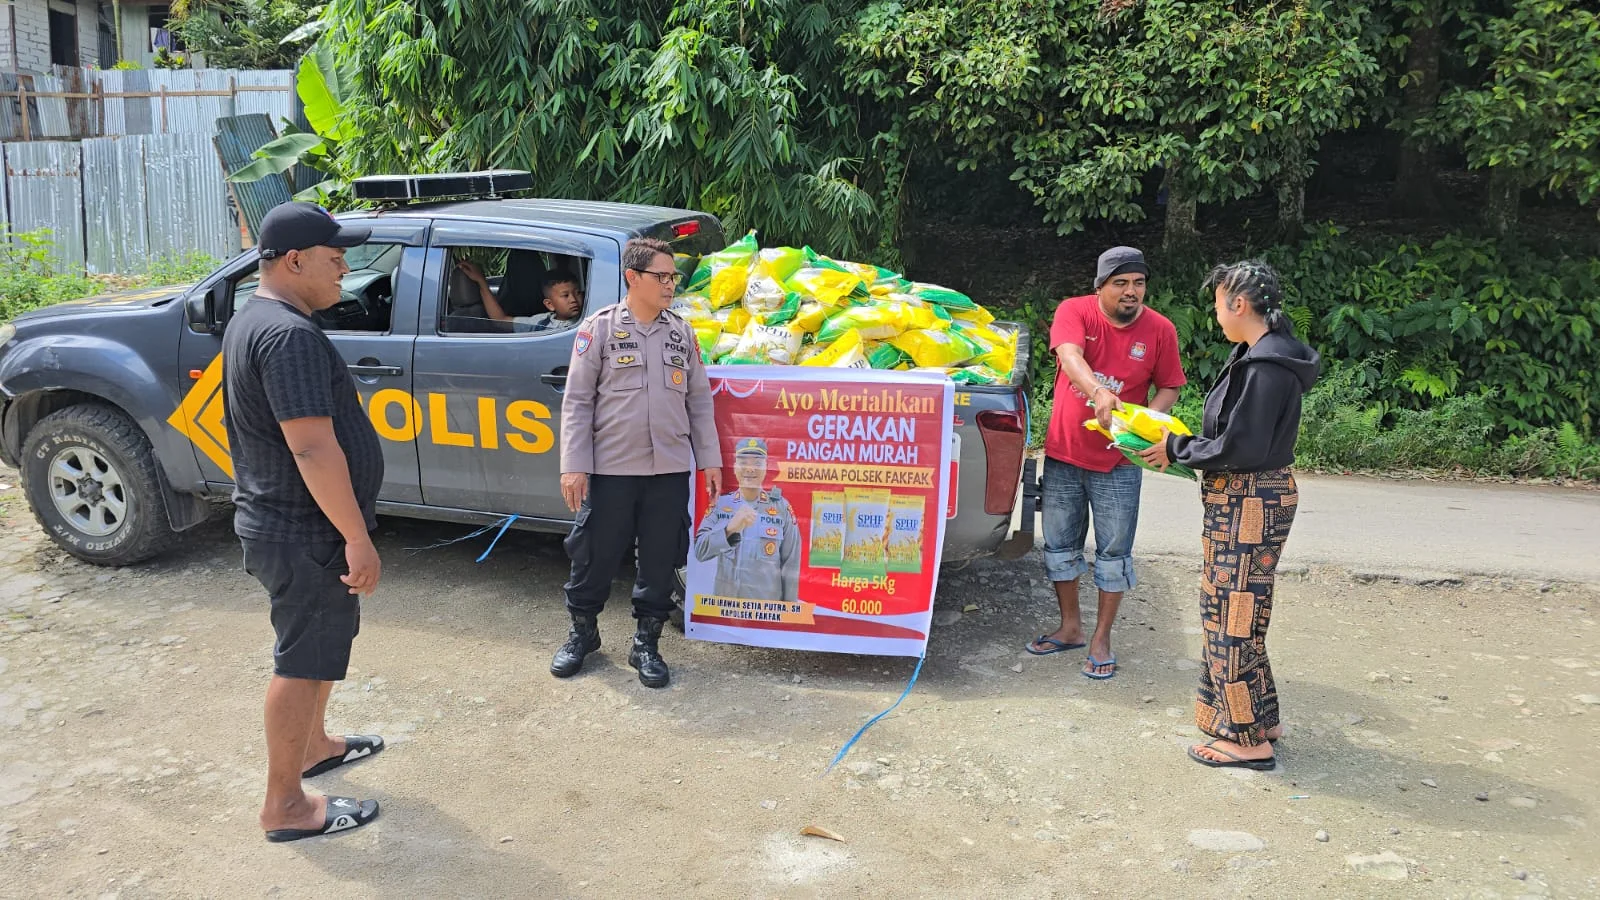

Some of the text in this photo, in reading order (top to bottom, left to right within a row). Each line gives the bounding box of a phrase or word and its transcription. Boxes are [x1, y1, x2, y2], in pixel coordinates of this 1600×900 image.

[665, 342, 687, 354] POLRI
[775, 387, 935, 417] Ayo Meriahkan
[357, 388, 555, 454] OLIS
[807, 414, 916, 443] GERAKAN
[36, 442, 50, 459] GT
[786, 440, 918, 465] PANGAN MURAH
[787, 467, 929, 486] BERSAMA POLSEK FAKFAK
[760, 516, 783, 525] POLRI
[857, 514, 883, 525] SPHP
[895, 519, 918, 529] SPHP
[831, 572, 896, 595] Harga 5Kg
[701, 597, 716, 606] IPTU
[717, 599, 740, 608] IRAWAN
[742, 601, 762, 610] SETIA
[791, 605, 801, 613] SH
[841, 598, 882, 615] 60.000
[720, 609, 781, 621] KAPOLSEK FAKFAK
